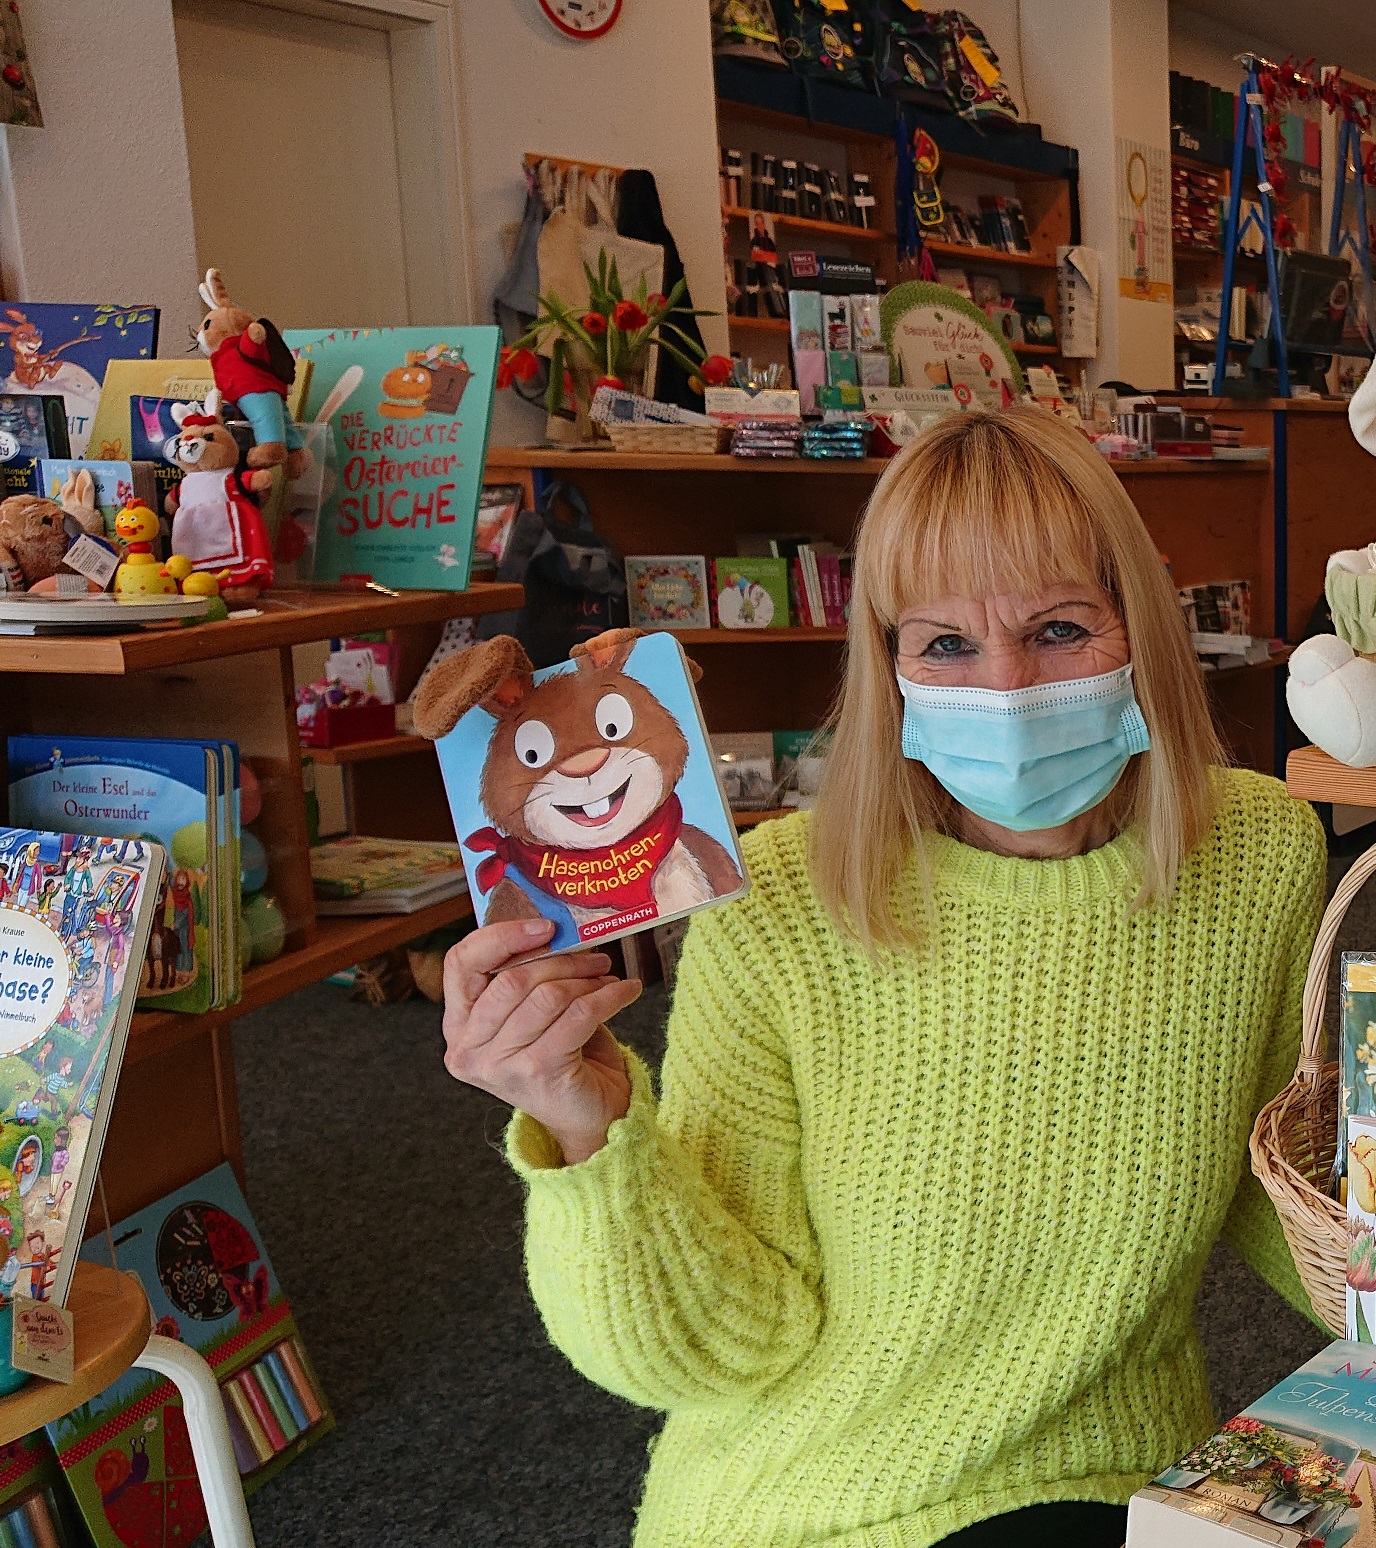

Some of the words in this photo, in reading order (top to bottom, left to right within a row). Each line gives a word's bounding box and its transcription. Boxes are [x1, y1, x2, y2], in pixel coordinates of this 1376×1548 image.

[822, 261, 872, 274] Lesezeichen
[341, 411, 365, 430] DIE
[343, 422, 463, 451] VERRÜCKTE
[343, 454, 464, 491] Ostereier-
[337, 483, 456, 536] SUCHE
[52, 780, 69, 793] Der
[72, 781, 98, 794] kleine
[101, 777, 129, 796] Esel
[64, 799, 150, 821] Osterwunder
[537, 832, 663, 879] Hasenohren-
[554, 858, 654, 897] verknoten
[2, 926, 25, 938] Krause
[582, 907, 654, 937] COPPENRATH
[13, 947, 54, 970] kleine
[1202, 1487, 1252, 1508] ROMAN
